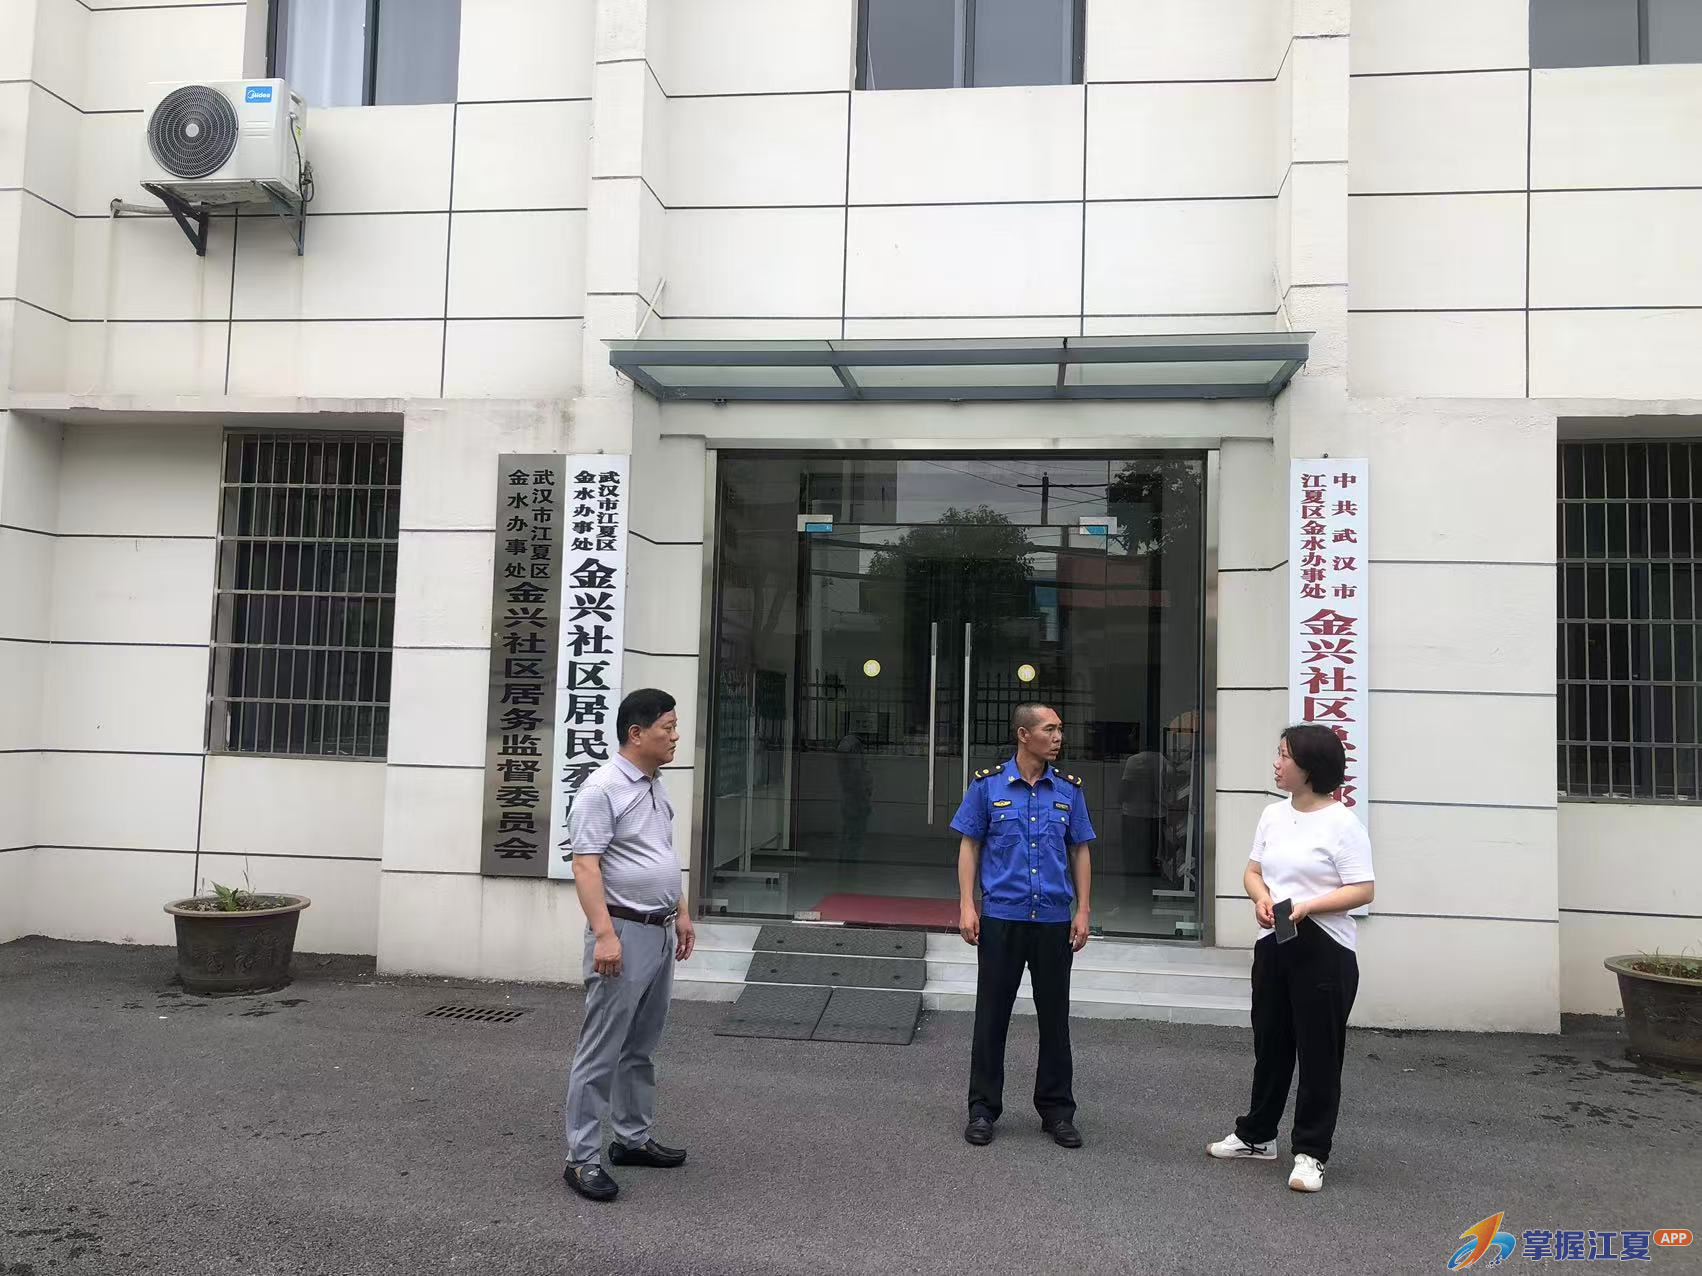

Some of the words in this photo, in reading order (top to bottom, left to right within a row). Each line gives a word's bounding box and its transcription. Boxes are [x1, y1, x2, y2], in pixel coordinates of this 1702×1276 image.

[247, 90, 271, 99] Midea
[504, 469, 530, 579] 金水办事处
[531, 469, 555, 579] 武汉市江夏区
[571, 470, 596, 551] 金水办事处
[596, 470, 620, 551] 武汉市江夏区
[1300, 473, 1327, 599] 江夏区金水办事处
[1331, 472, 1358, 599] 中共武汉市
[494, 581, 550, 860] 金兴社区居务监督委员会
[558, 557, 618, 863] 金兴社区居民委
[1300, 608, 1358, 808] 金兴社区
